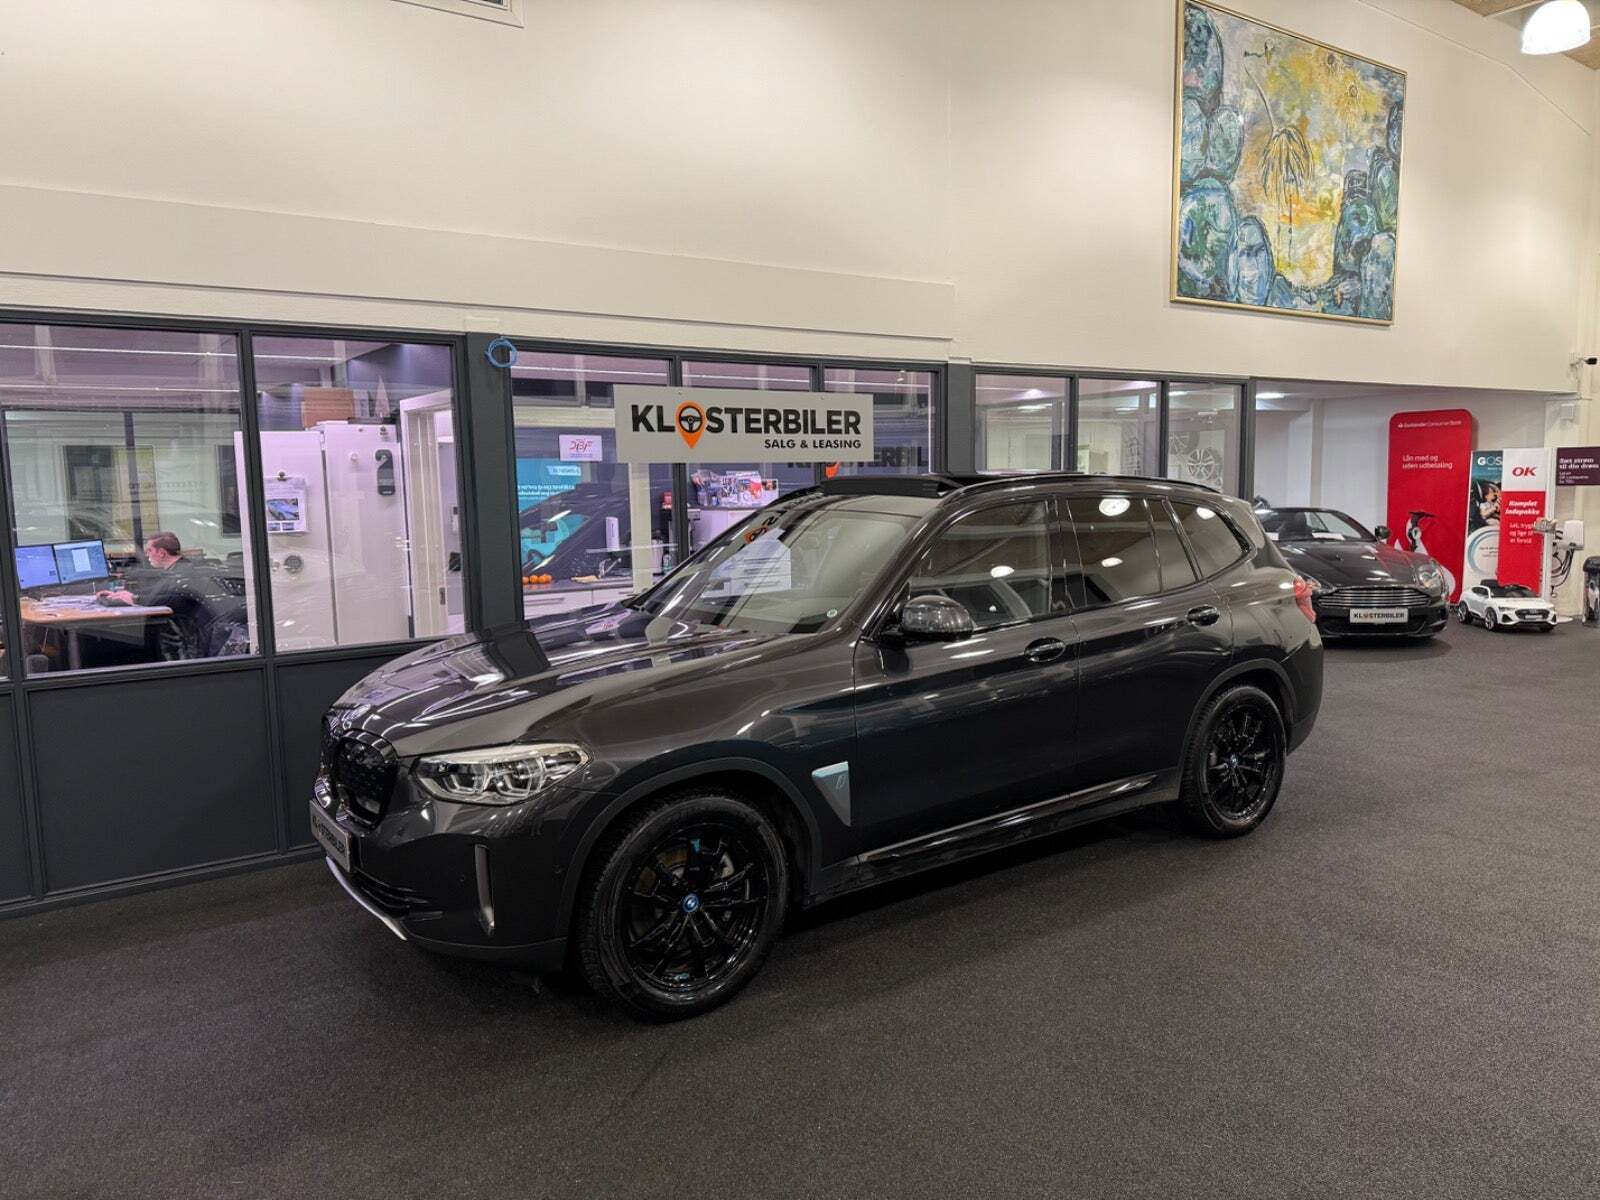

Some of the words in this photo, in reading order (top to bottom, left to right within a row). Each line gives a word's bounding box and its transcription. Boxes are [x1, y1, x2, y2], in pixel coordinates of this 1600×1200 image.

[631, 403, 862, 435] KLOSTERBILER
[764, 438, 796, 449] SALG
[800, 439, 809, 449] &
[812, 439, 862, 449] LEASING
[1402, 454, 1414, 462] Lån
[1511, 466, 1537, 477] OK
